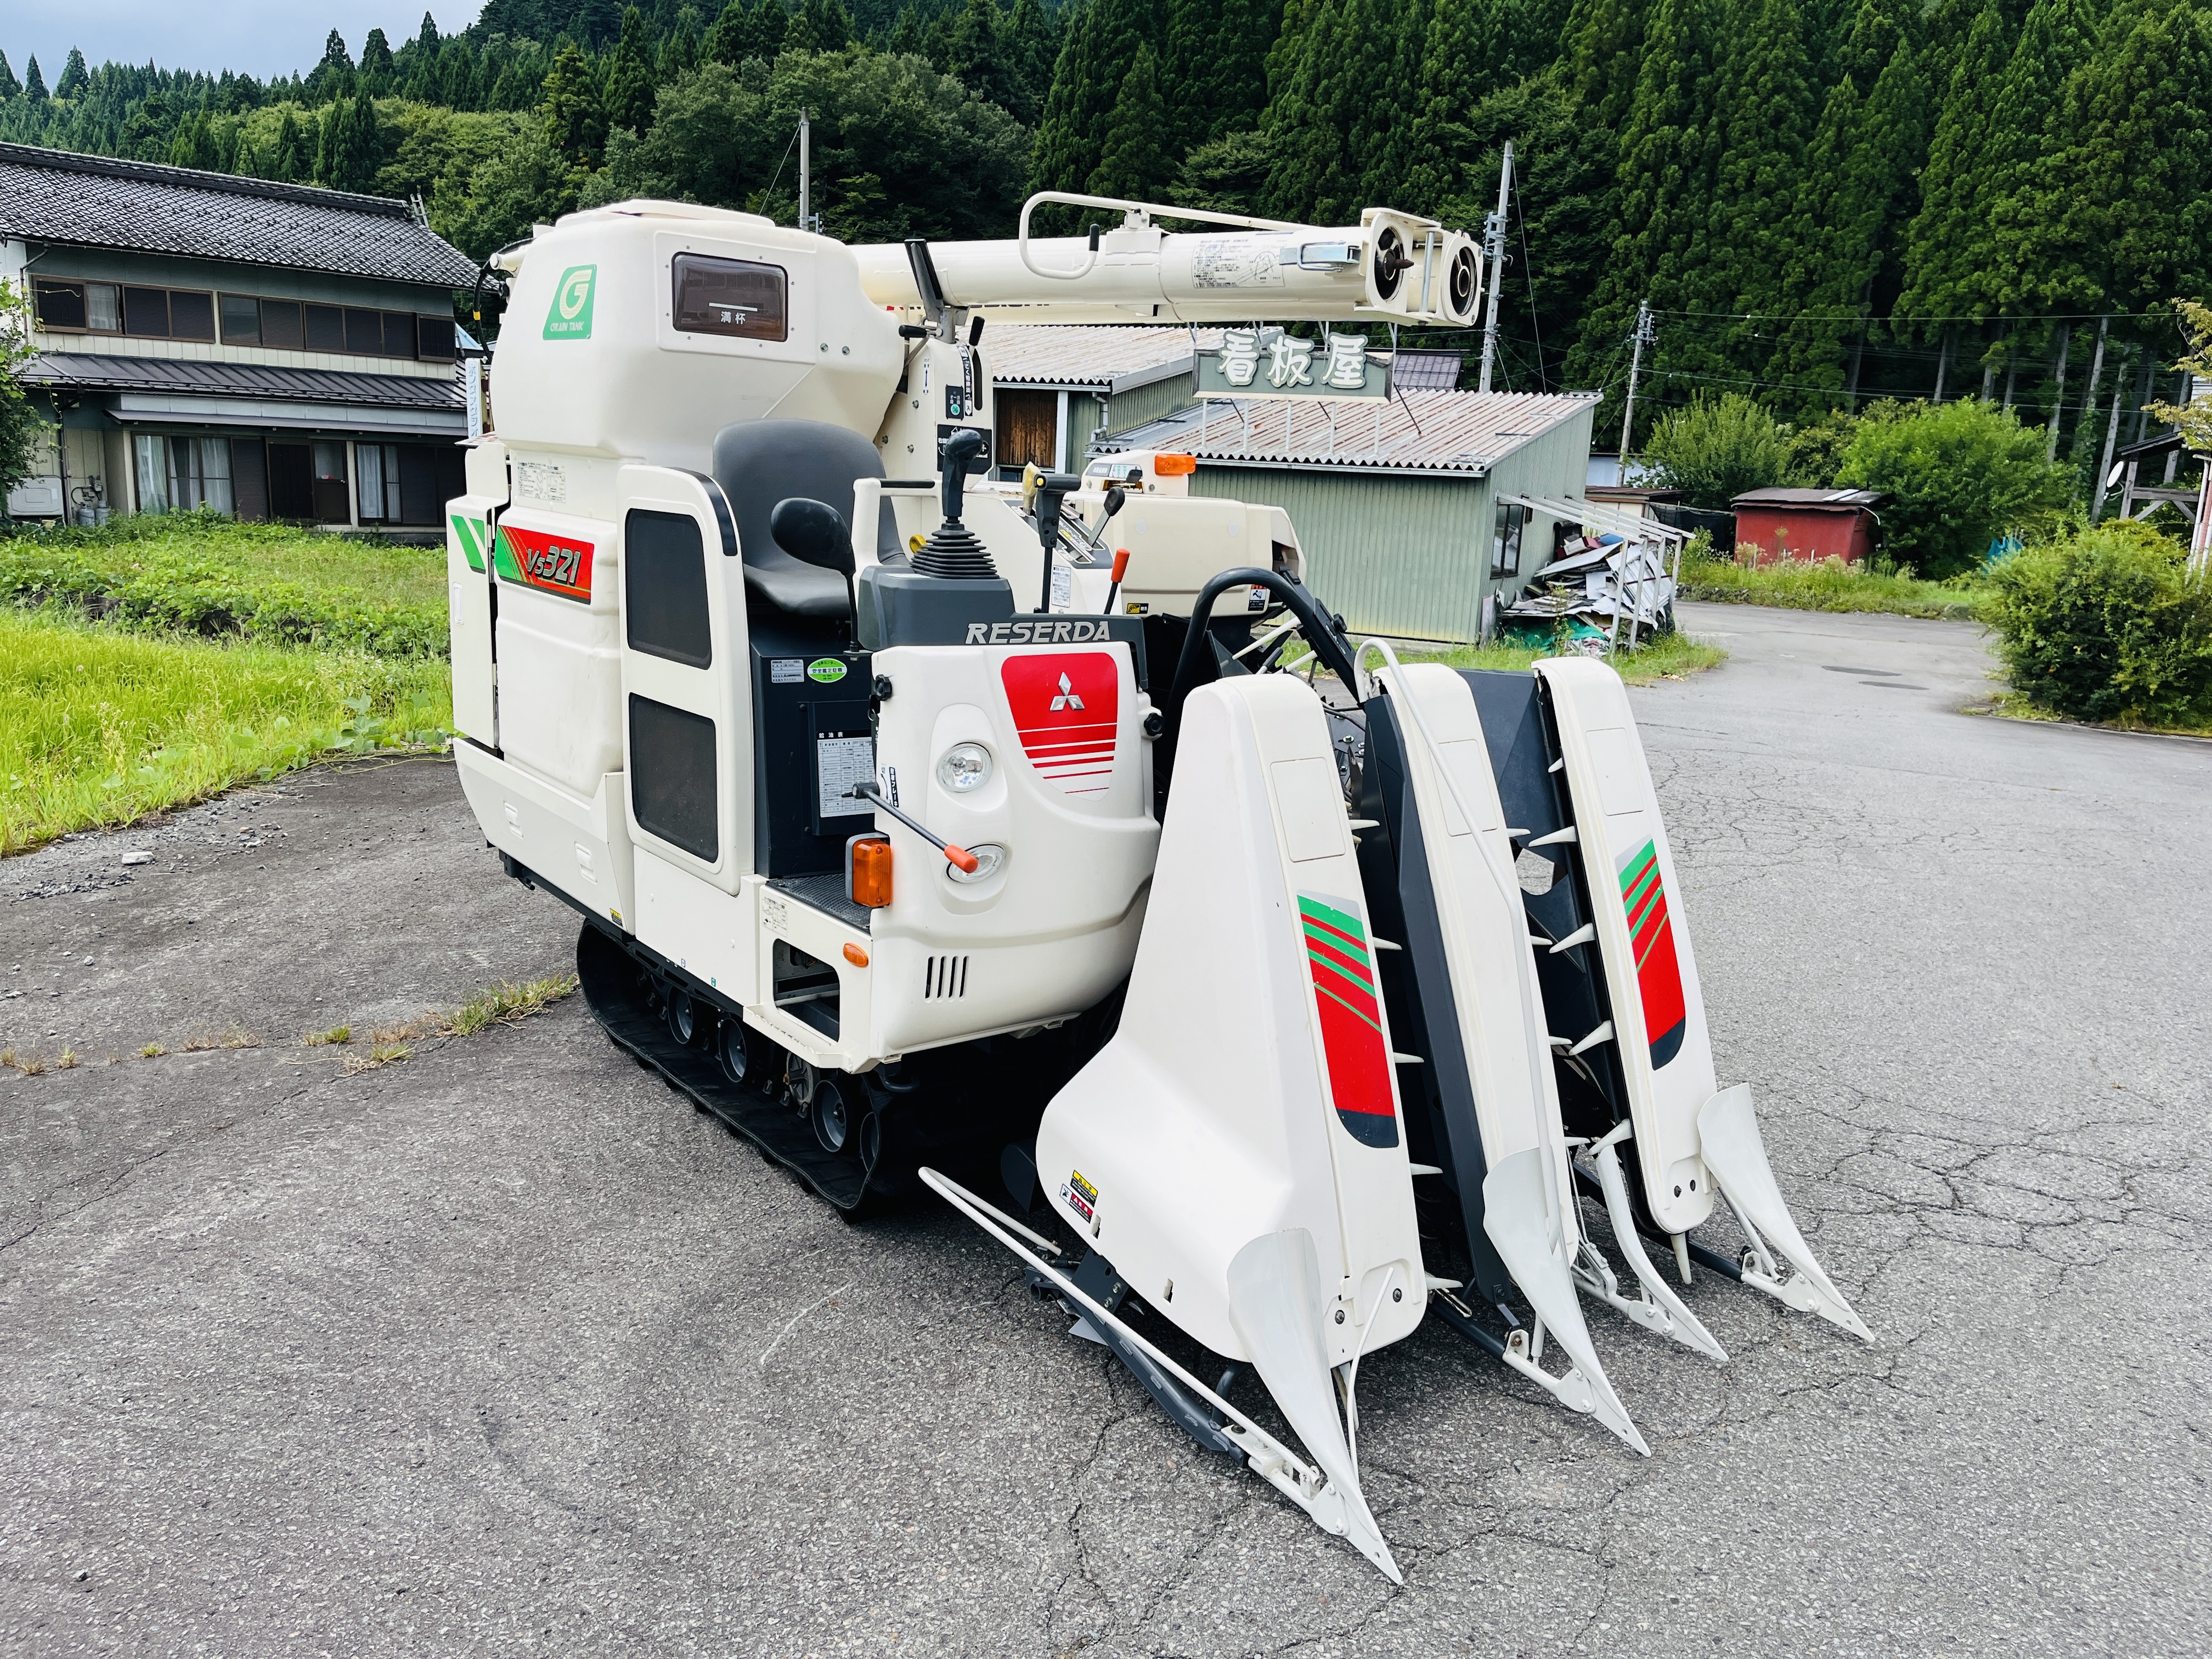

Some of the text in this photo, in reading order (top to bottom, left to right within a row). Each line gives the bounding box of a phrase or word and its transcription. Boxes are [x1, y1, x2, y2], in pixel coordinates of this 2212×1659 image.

[559, 268, 592, 320] G
[550, 321, 585, 332] GRAIN TANK
[720, 311, 746, 325] 満杯
[1218, 331, 1367, 387] 看板屋
[965, 620, 1110, 645] RESERDA
